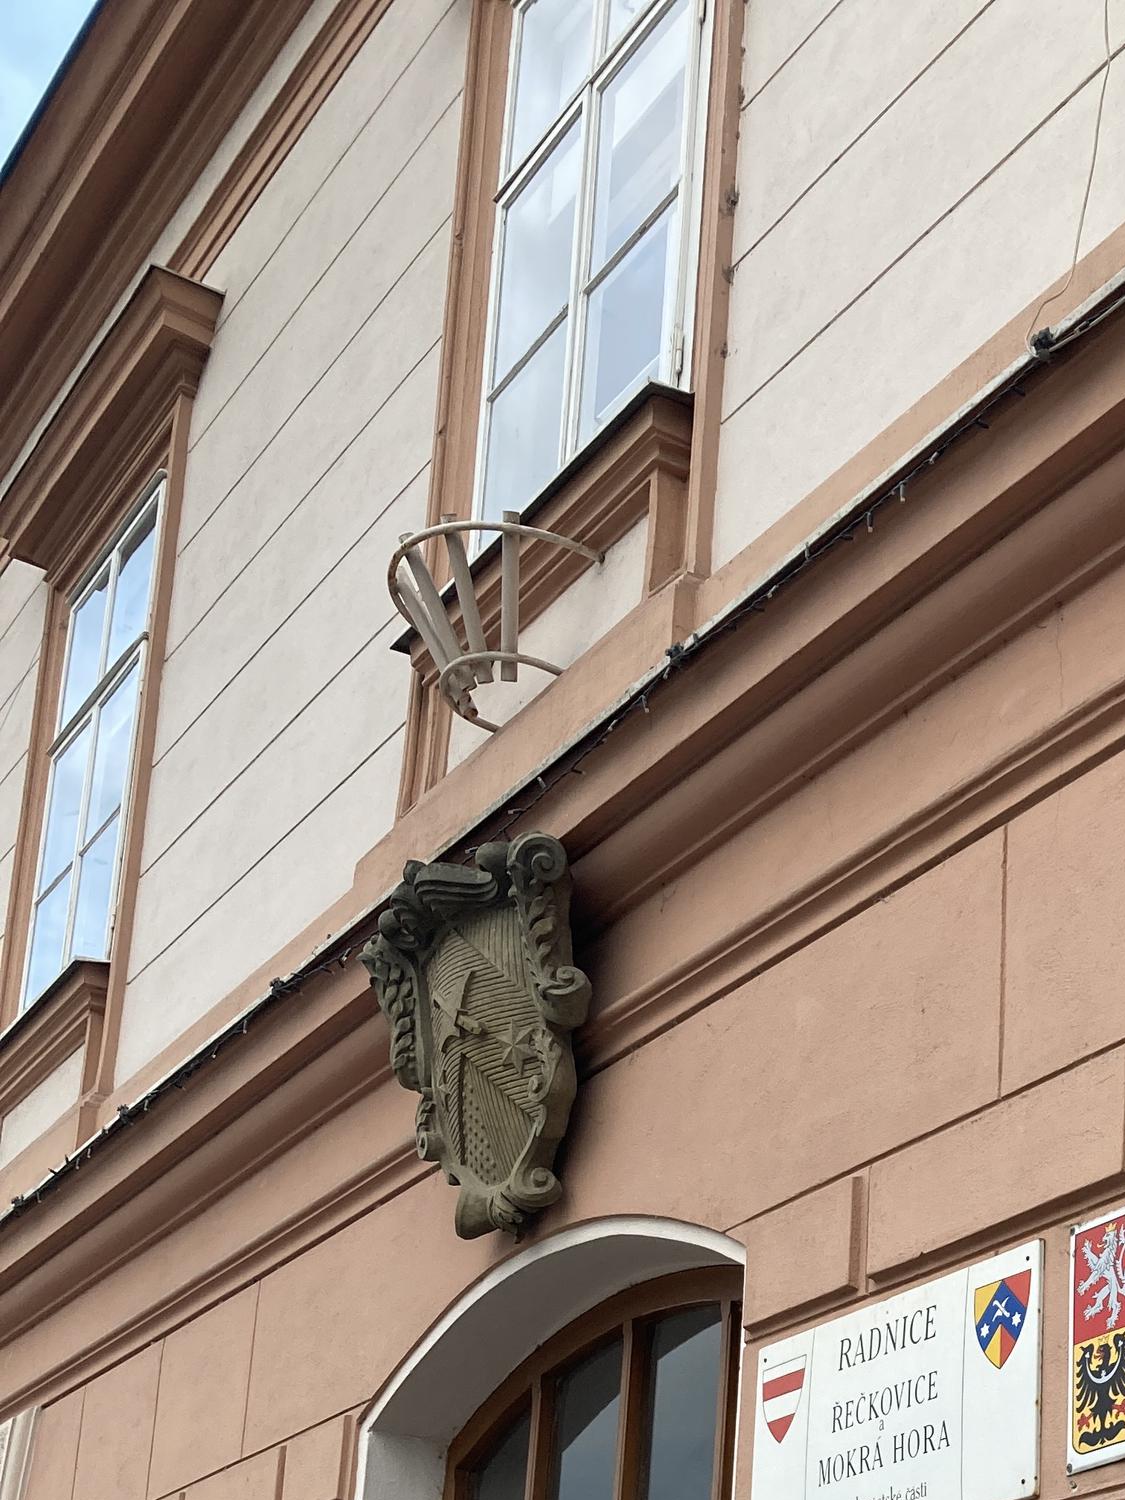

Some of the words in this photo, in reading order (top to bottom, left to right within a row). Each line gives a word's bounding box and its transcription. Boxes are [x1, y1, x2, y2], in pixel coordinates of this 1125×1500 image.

[838, 1304, 937, 1371] RADNICE
[832, 1371, 938, 1433] ŘEČKOVICE
[879, 1420, 885, 1431] a
[818, 1436, 884, 1487] MOKRÁ
[893, 1420, 951, 1464] HORA
